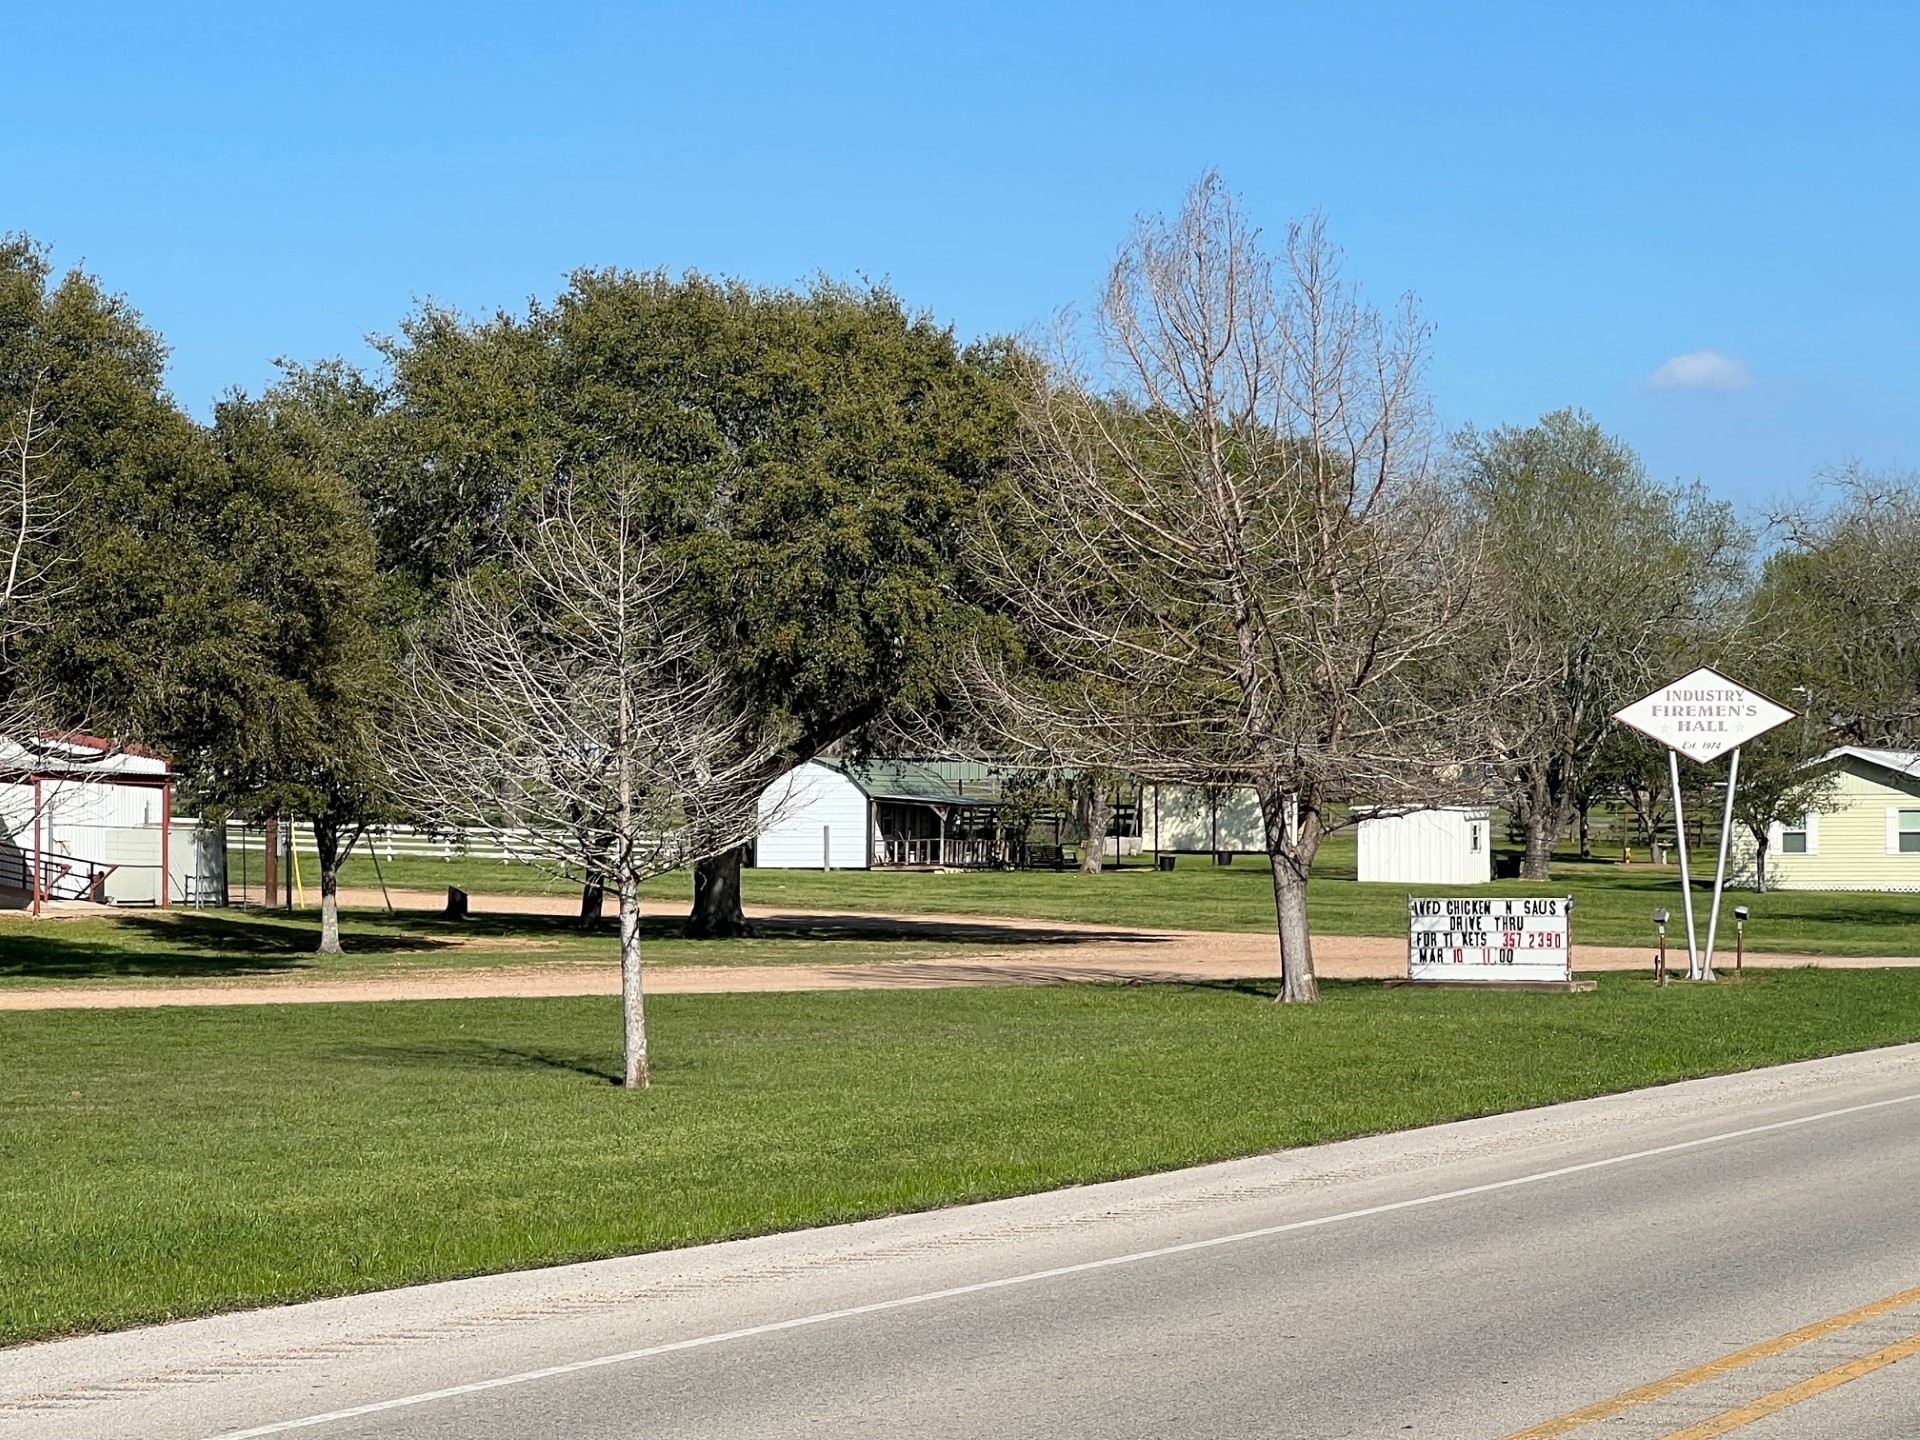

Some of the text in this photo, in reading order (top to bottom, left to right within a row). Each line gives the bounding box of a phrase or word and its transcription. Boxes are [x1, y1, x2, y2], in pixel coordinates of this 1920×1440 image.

[1666, 689, 1744, 702] INDUSTRY
[1651, 705, 1757, 717] FIREMEN'S
[1677, 720, 1728, 732] HALL
[1702, 742, 1722, 750] 1974
[1446, 900, 1491, 915] CHICKEN
[1505, 900, 1512, 915] N
[1524, 900, 1556, 915] SAUS
[1450, 916, 1524, 931] DRIVE THRU
[1416, 932, 1437, 947] FOR
[1503, 932, 1521, 947] 357
[1529, 933, 1561, 948] 2390
[1419, 948, 1443, 963] MAR
[1453, 948, 1463, 963] 10
